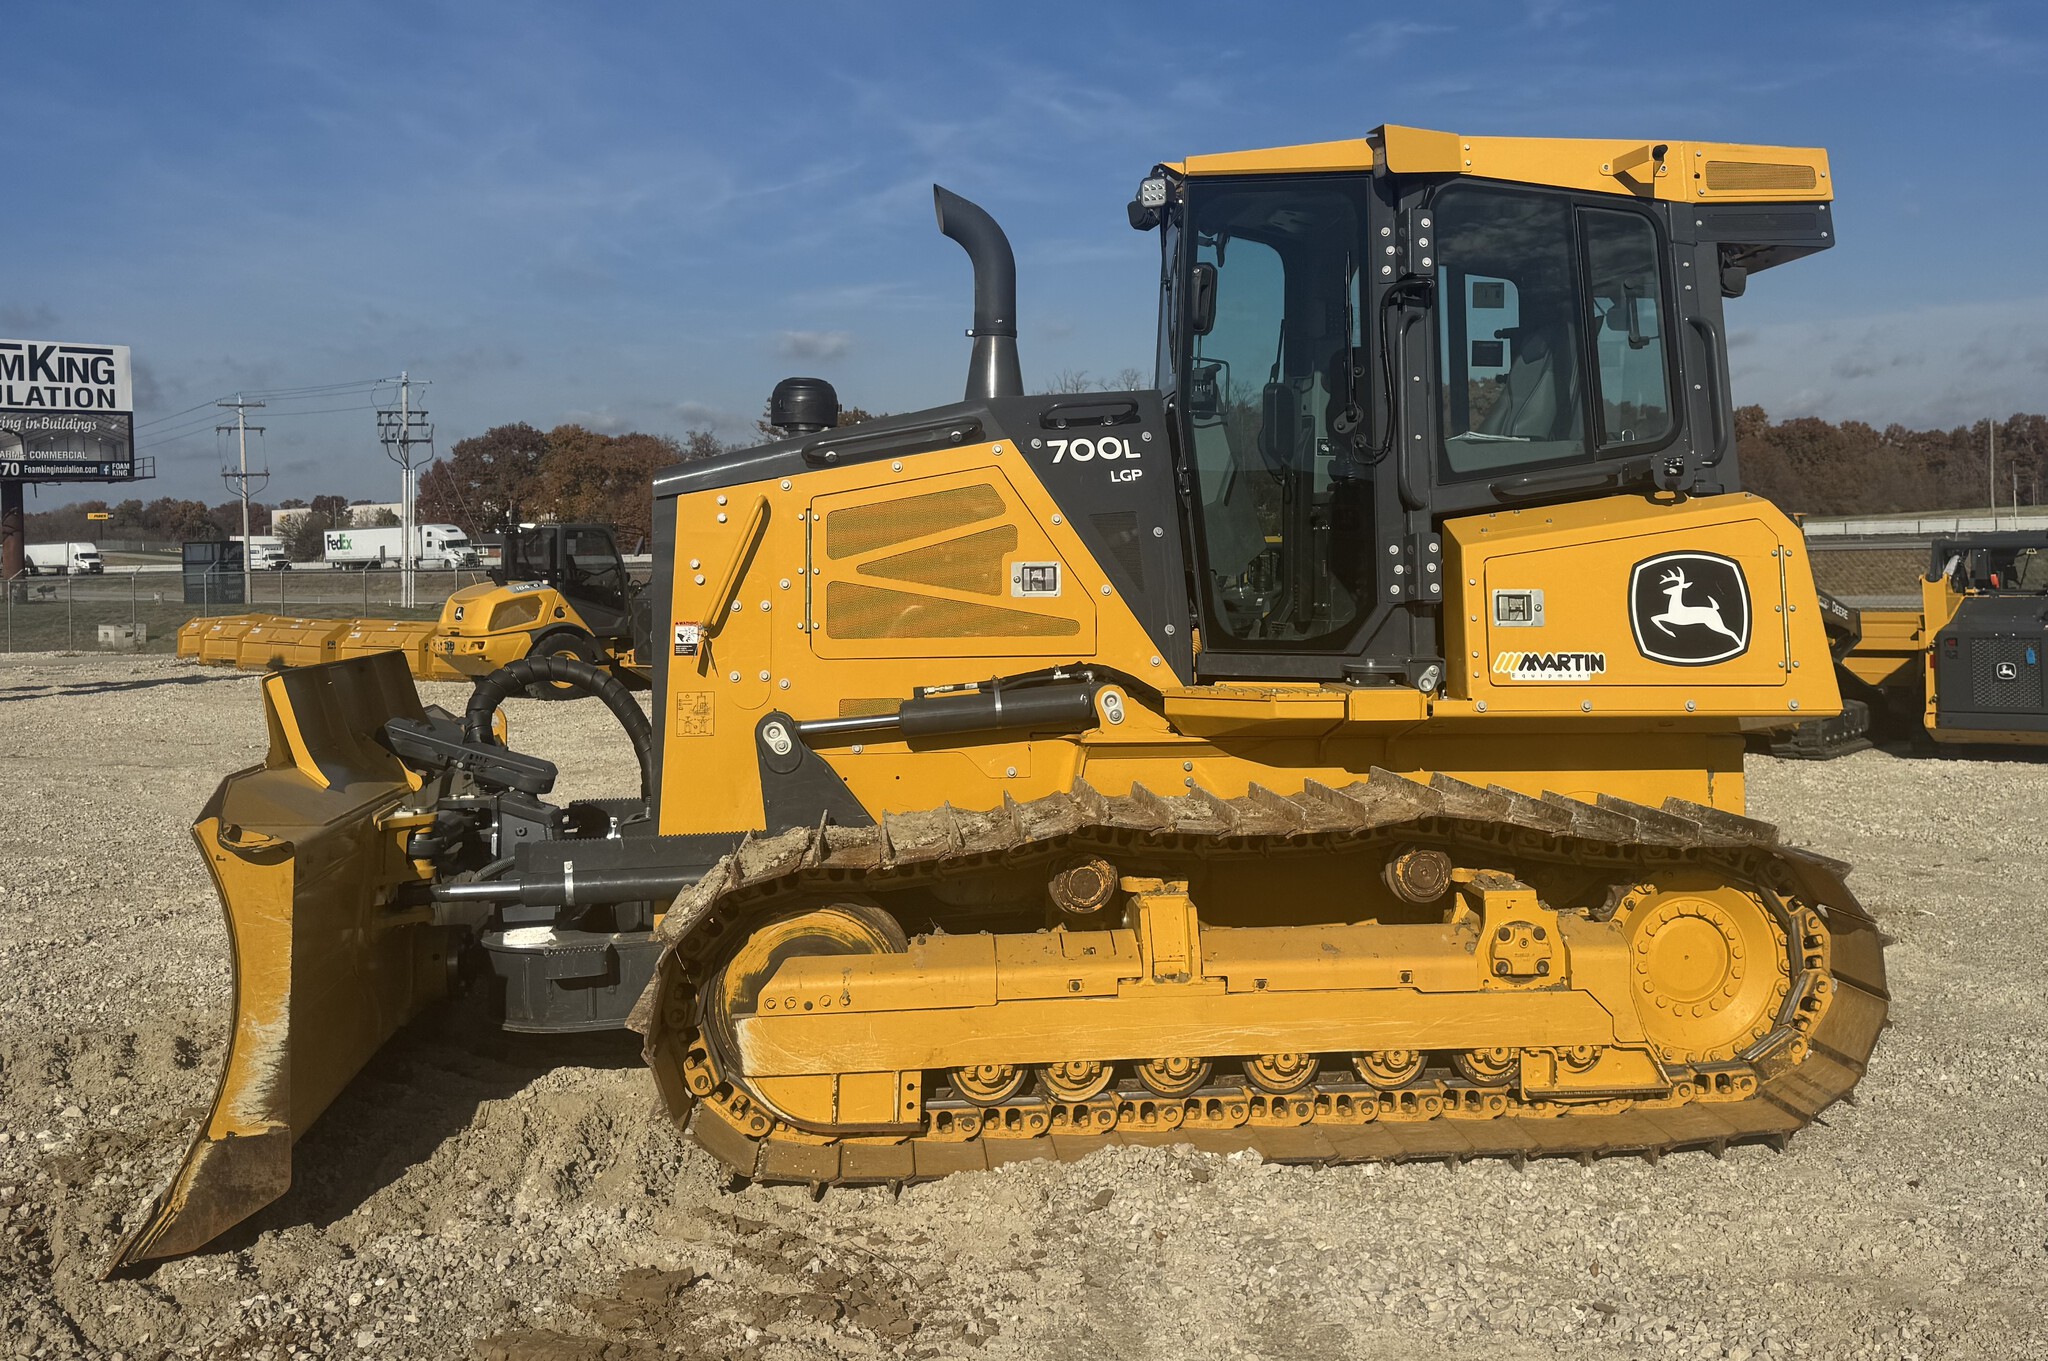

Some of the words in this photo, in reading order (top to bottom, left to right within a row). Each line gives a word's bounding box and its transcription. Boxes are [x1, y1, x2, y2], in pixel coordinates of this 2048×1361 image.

[0, 415, 21, 432] ing
[25, 416, 37, 429] in
[41, 417, 97, 433] Buildings
[29, 450, 87, 459] COMMERCIAL
[1046, 436, 1142, 464] 700L
[0, 462, 20, 476] 70
[112, 469, 128, 477] KING
[1110, 469, 1143, 483] LGP
[326, 533, 353, 551] FedEx
[1832, 601, 1849, 620] DEERE
[1518, 653, 1605, 672] MARTIN
